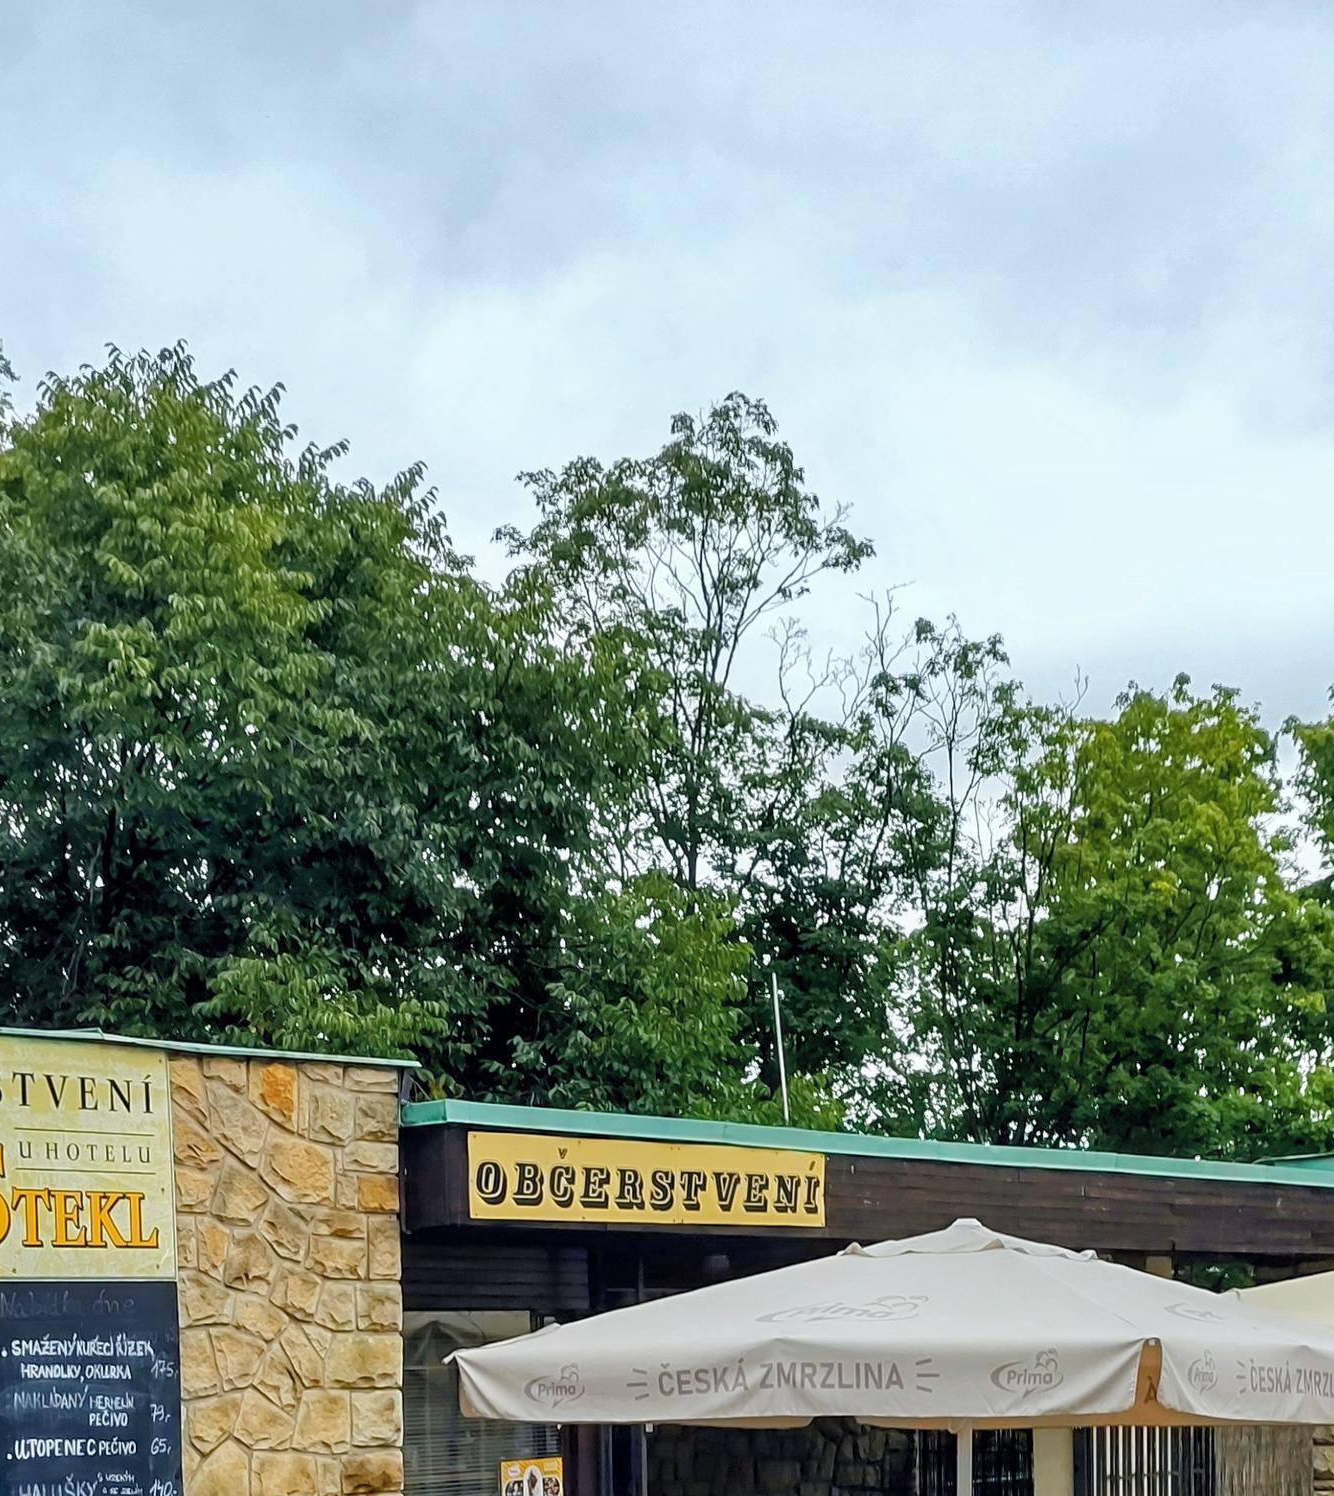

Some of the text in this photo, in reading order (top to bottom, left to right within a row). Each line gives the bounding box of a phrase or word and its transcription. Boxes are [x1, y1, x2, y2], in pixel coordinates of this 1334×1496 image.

[19, 1140, 152, 1164] U HOTELU
[475, 1147, 819, 1214] OBČERSTVENÍ
[658, 1357, 904, 1397] ČESKÁ ZMRZLINA
[1249, 1358, 1292, 1394] ČESKÁ
[89, 1410, 128, 1427] PEČIVO
[14, 1438, 97, 1460] UTOPENEC
